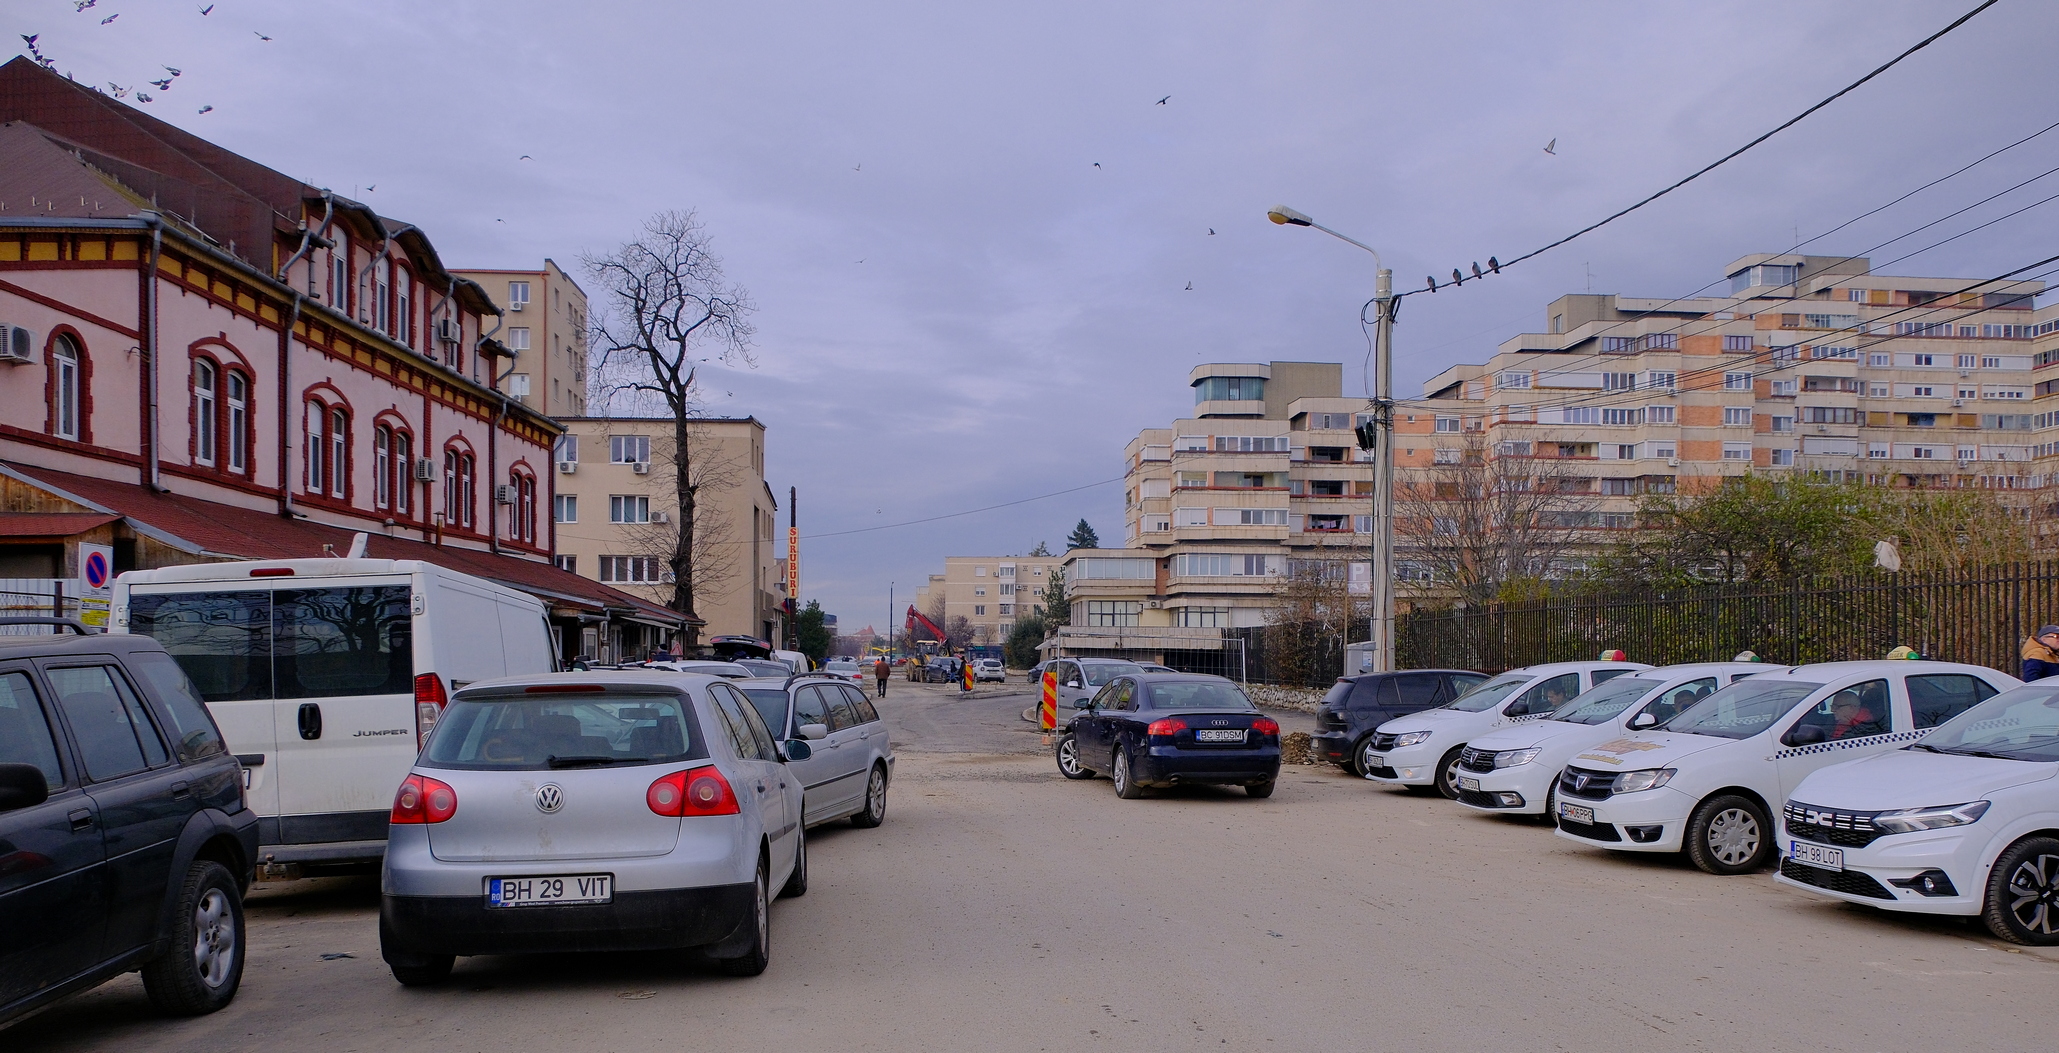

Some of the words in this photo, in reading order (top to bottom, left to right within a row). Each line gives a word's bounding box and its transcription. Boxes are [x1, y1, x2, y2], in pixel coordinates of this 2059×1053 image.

[789, 528, 797, 597] SURUBURI
[1352, 564, 1365, 581] P
[352, 728, 408, 738] JUMPER
[1200, 731, 1212, 739] BC
[1795, 844, 1808, 859] BH
[1810, 847, 1821, 862] 98
[1823, 849, 1840, 866] LOT
[491, 893, 501, 901] RO
[503, 880, 532, 901] BH
[539, 878, 564, 899] 29
[577, 876, 608, 897] VIT
